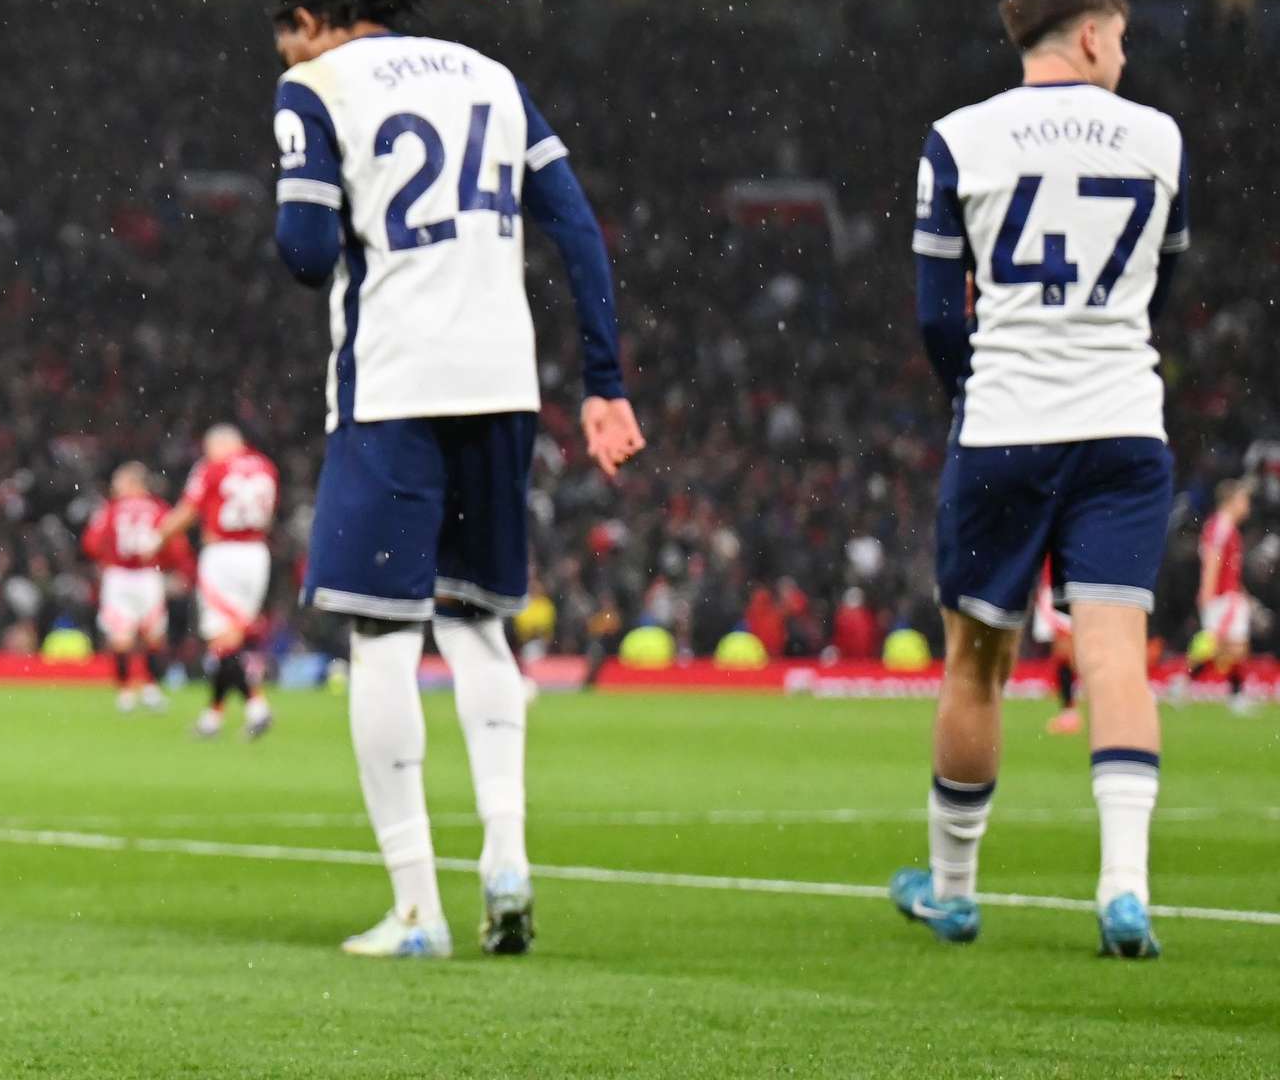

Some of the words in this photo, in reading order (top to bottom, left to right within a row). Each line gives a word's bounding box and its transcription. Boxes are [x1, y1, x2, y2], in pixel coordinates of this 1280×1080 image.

[372, 52, 476, 90] SPENCE
[373, 102, 520, 252] 24
[1009, 117, 1130, 153] MOORE
[991, 175, 1156, 306] 47
